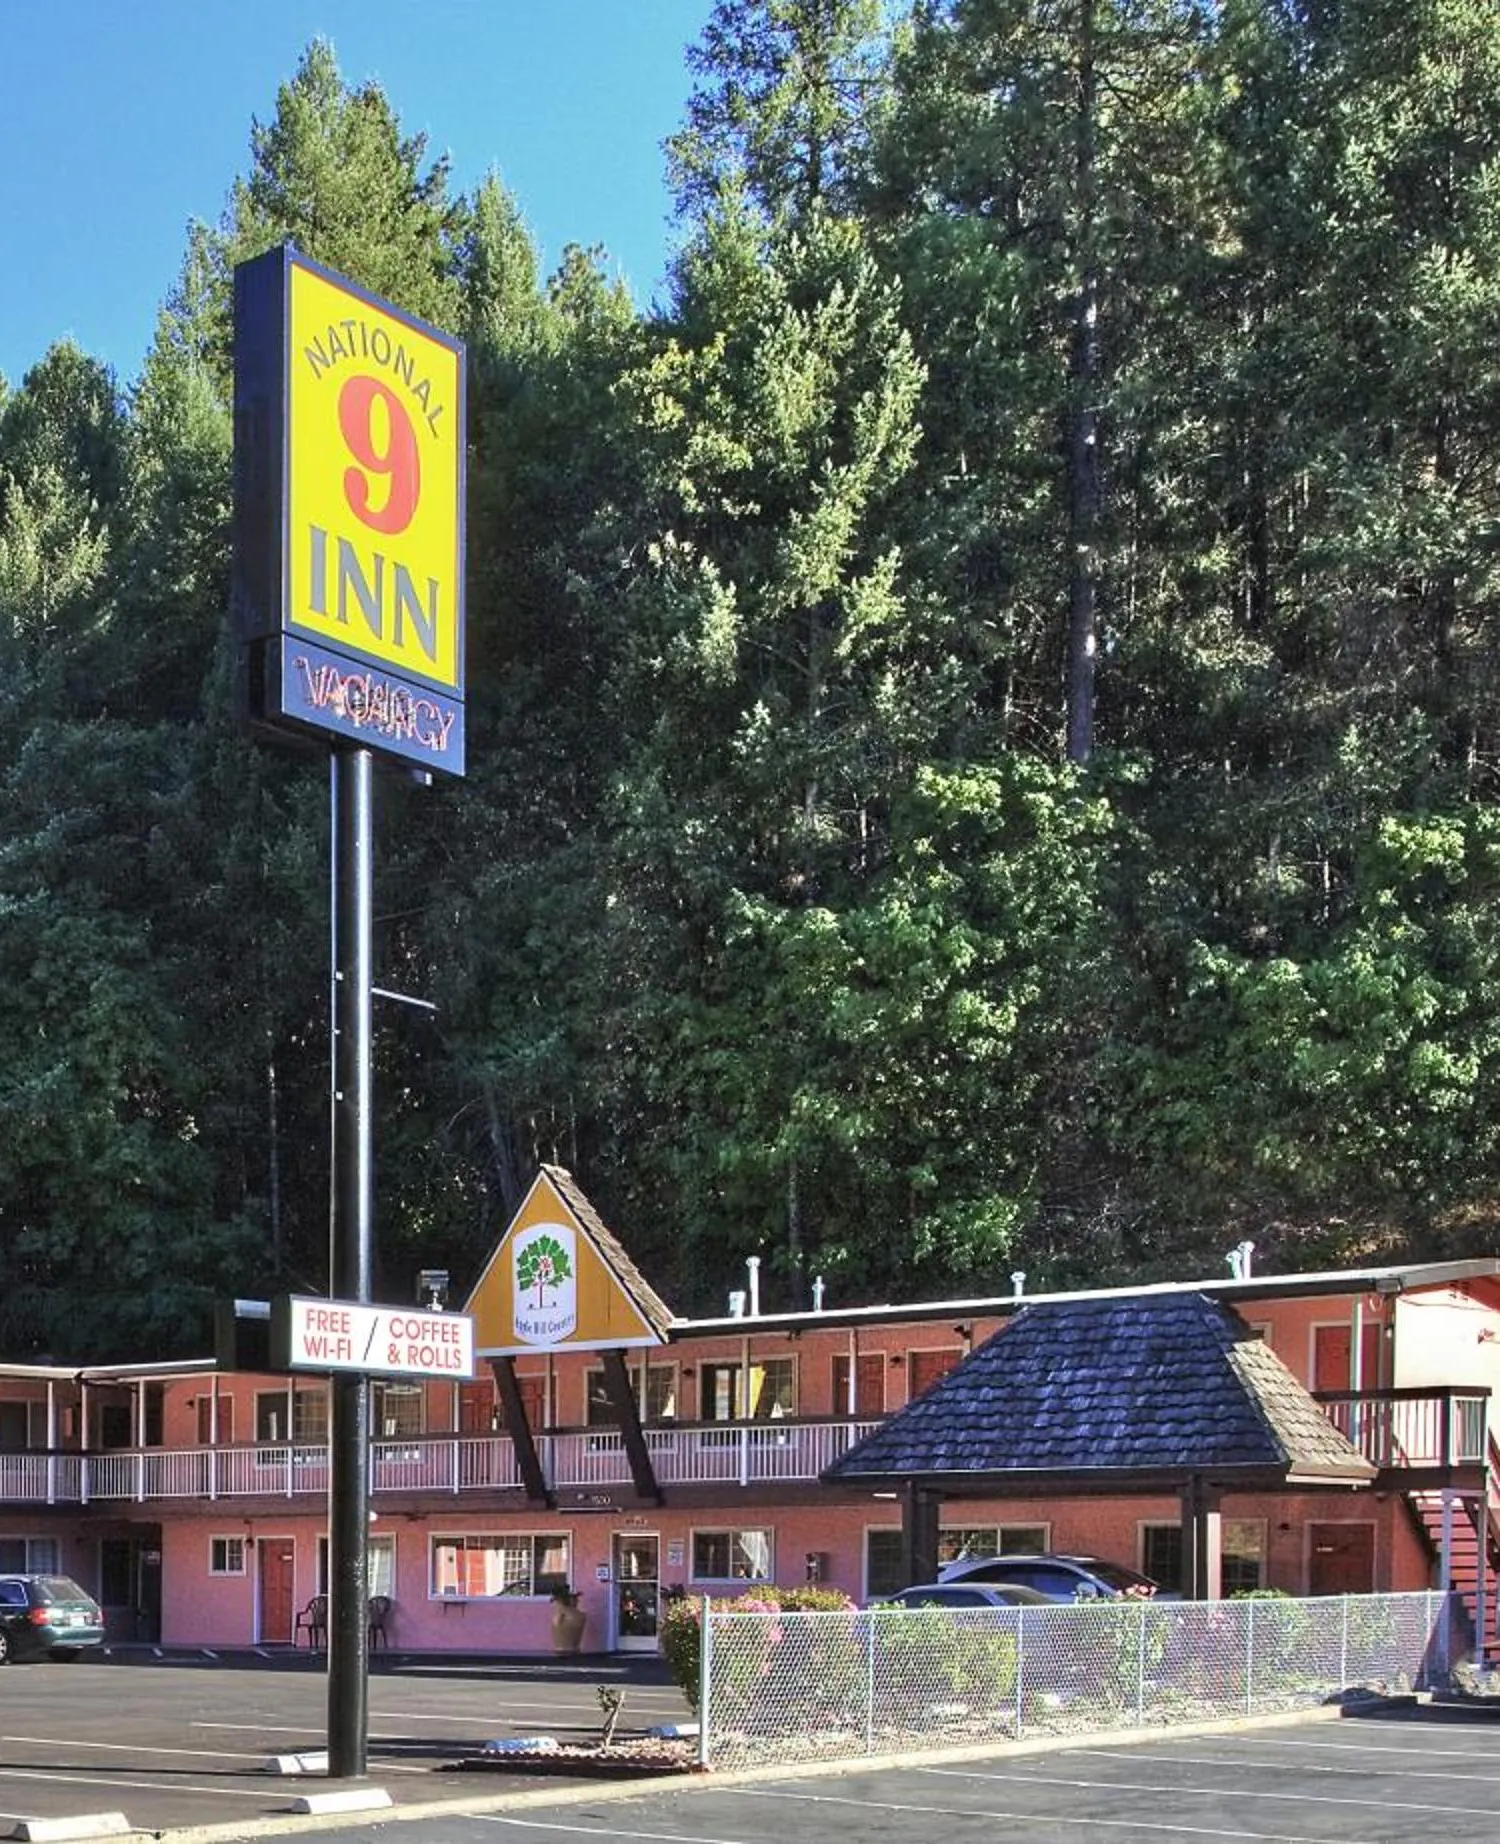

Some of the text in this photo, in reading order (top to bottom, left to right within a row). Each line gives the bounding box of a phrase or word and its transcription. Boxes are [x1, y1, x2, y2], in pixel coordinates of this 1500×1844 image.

[304, 320, 444, 438] NATIONAL
[338, 375, 421, 535] 9
[308, 525, 439, 665] INN
[293, 656, 455, 751] VACANCY
[303, 1334, 351, 1361] WI-FI
[305, 1308, 351, 1333] FREE
[389, 1317, 461, 1344] COFFEE
[387, 1343, 462, 1369] & ROLLS
